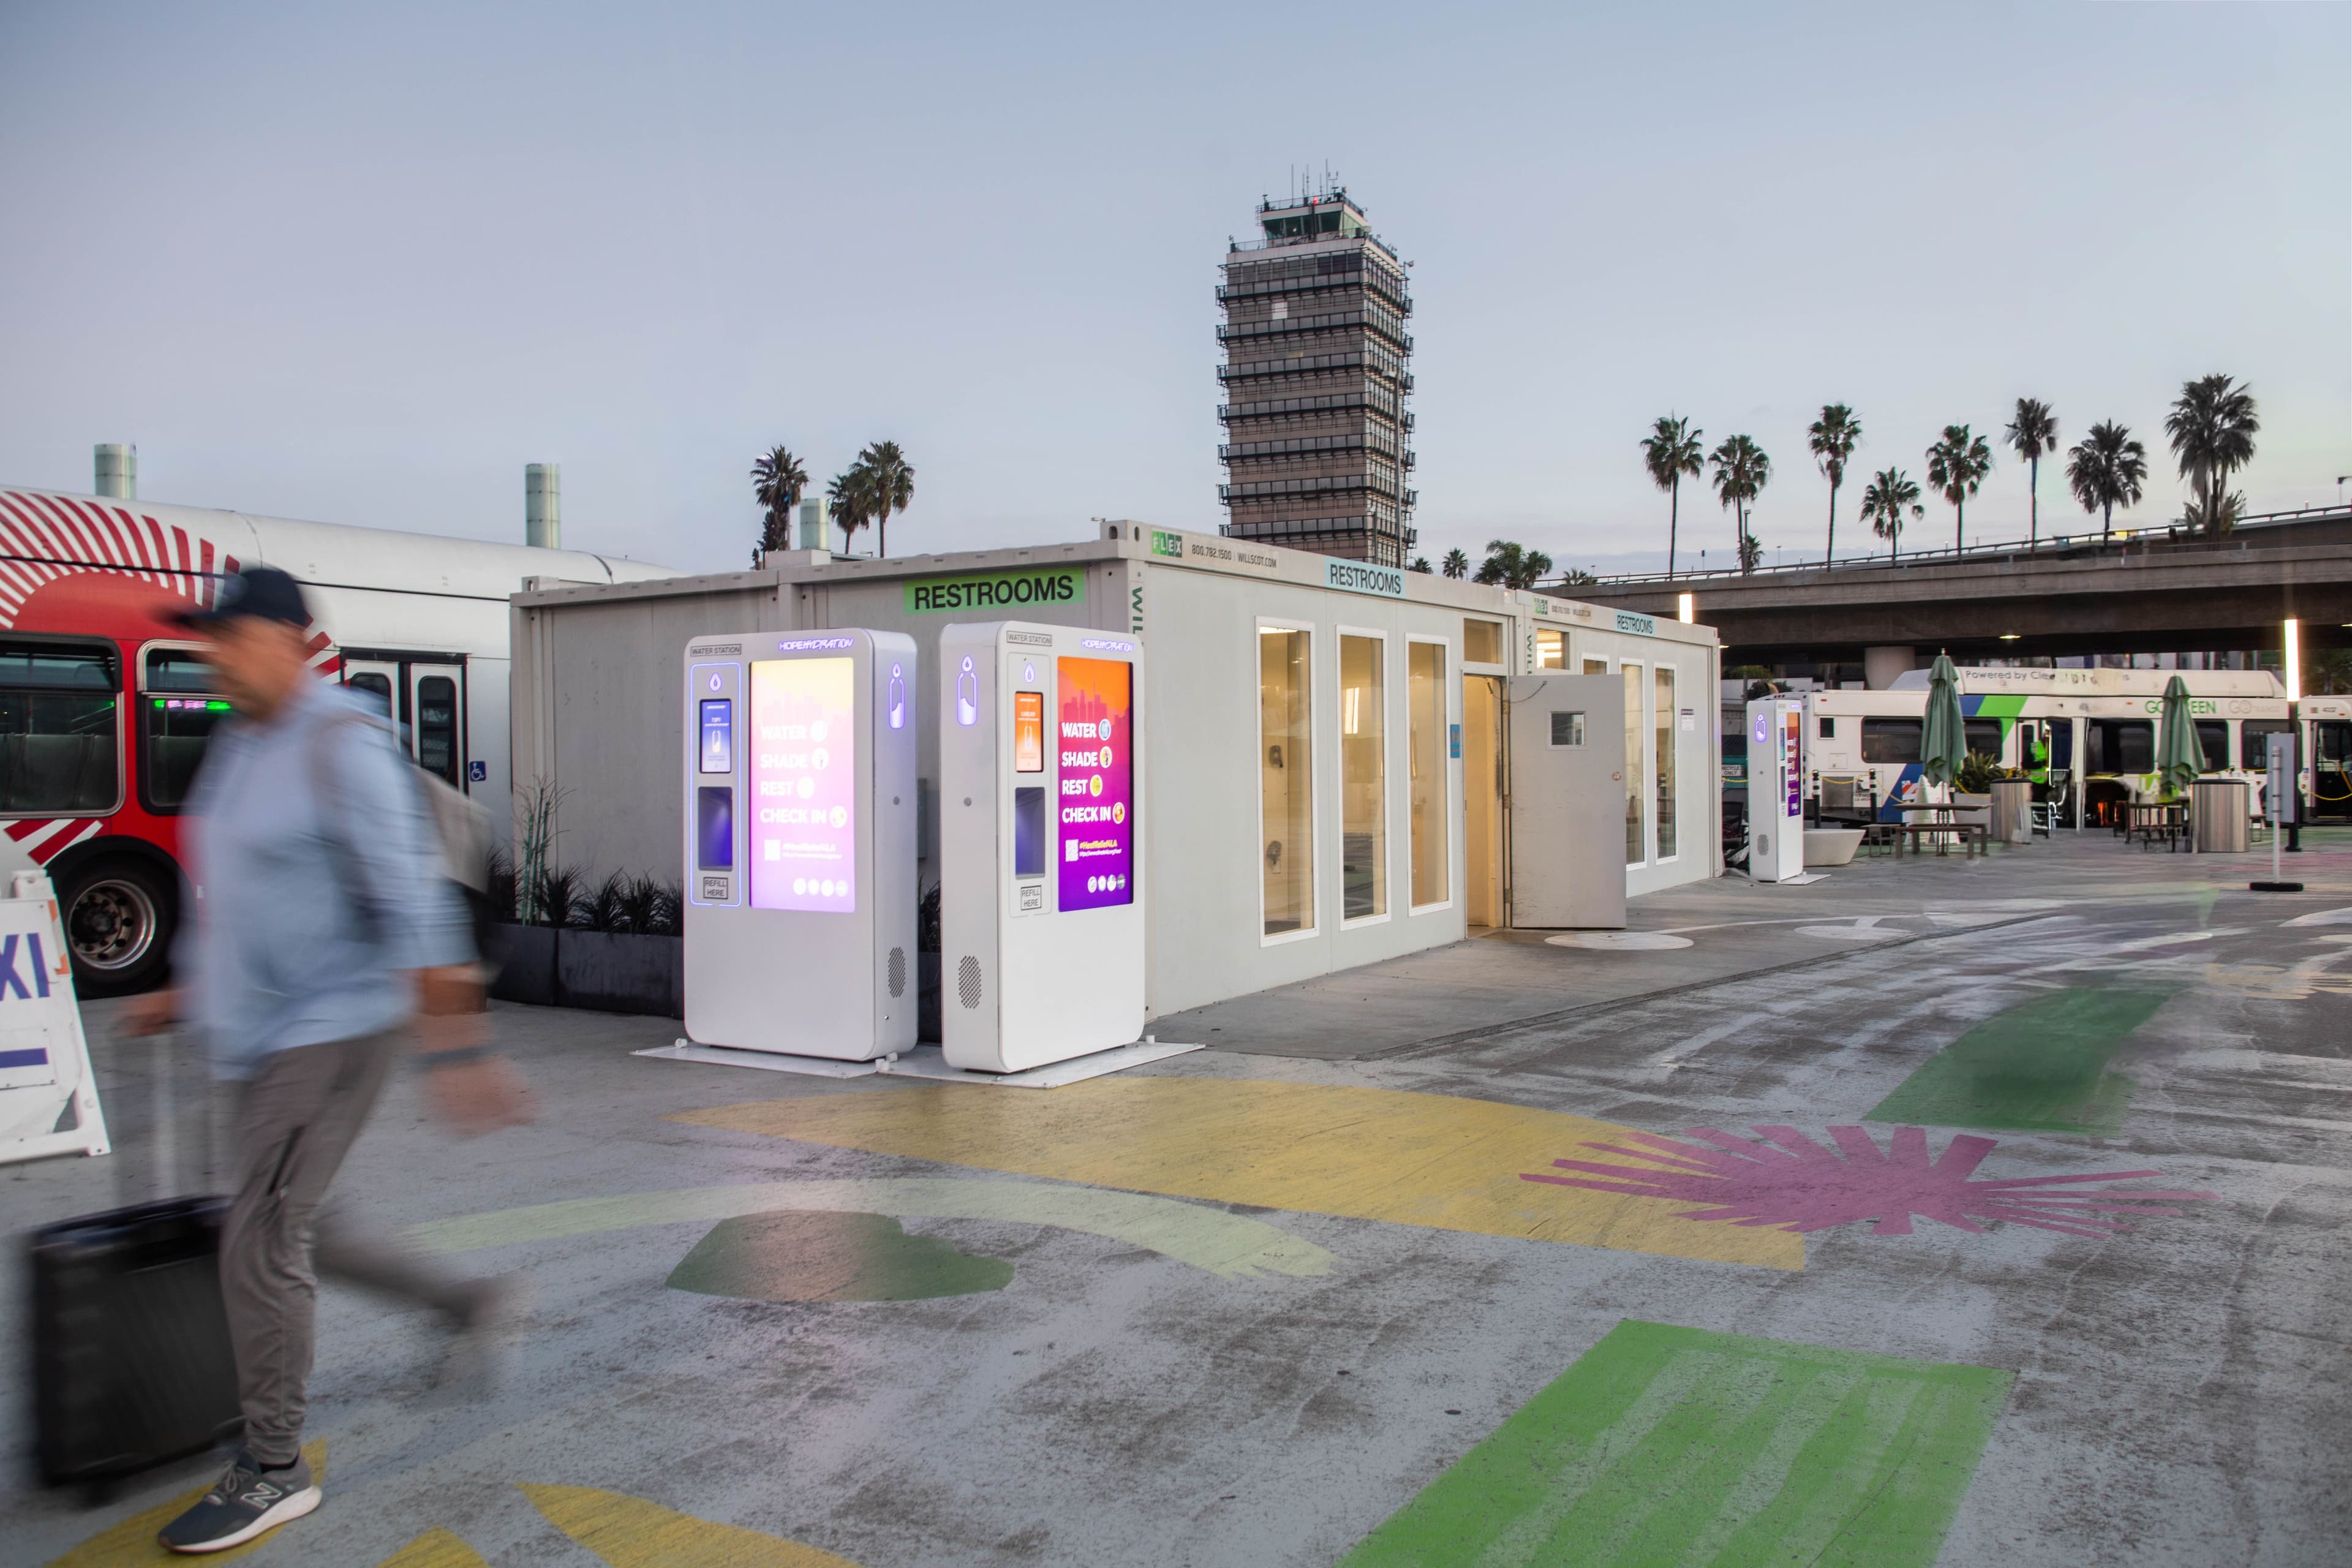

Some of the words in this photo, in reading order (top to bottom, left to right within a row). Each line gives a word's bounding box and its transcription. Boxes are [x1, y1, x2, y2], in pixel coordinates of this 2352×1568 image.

[1152, 537, 1182, 553] FLEX
[1192, 544, 1231, 560] 800.782.1500
[1237, 552, 1277, 568] WILLSCOT.COM
[1330, 564, 1401, 594] RESTROOMS
[914, 575, 1074, 610] RESTROOMS
[1132, 586, 1144, 635] WIL
[1617, 614, 1653, 635] RESTROOMS
[1029, 636, 1050, 644] STATION
[2014, 671, 2027, 680] by
[760, 725, 807, 741] WATER
[1061, 722, 1096, 738] WATER
[760, 754, 809, 769] SHADE
[1061, 751, 1098, 767] SHADE
[760, 780, 794, 796] REST
[1062, 779, 1088, 795] REST
[760, 807, 808, 824] CHECK
[811, 808, 827, 824] IN
[1062, 807, 1099, 823] CHECK
[1100, 806, 1111, 821] IN
